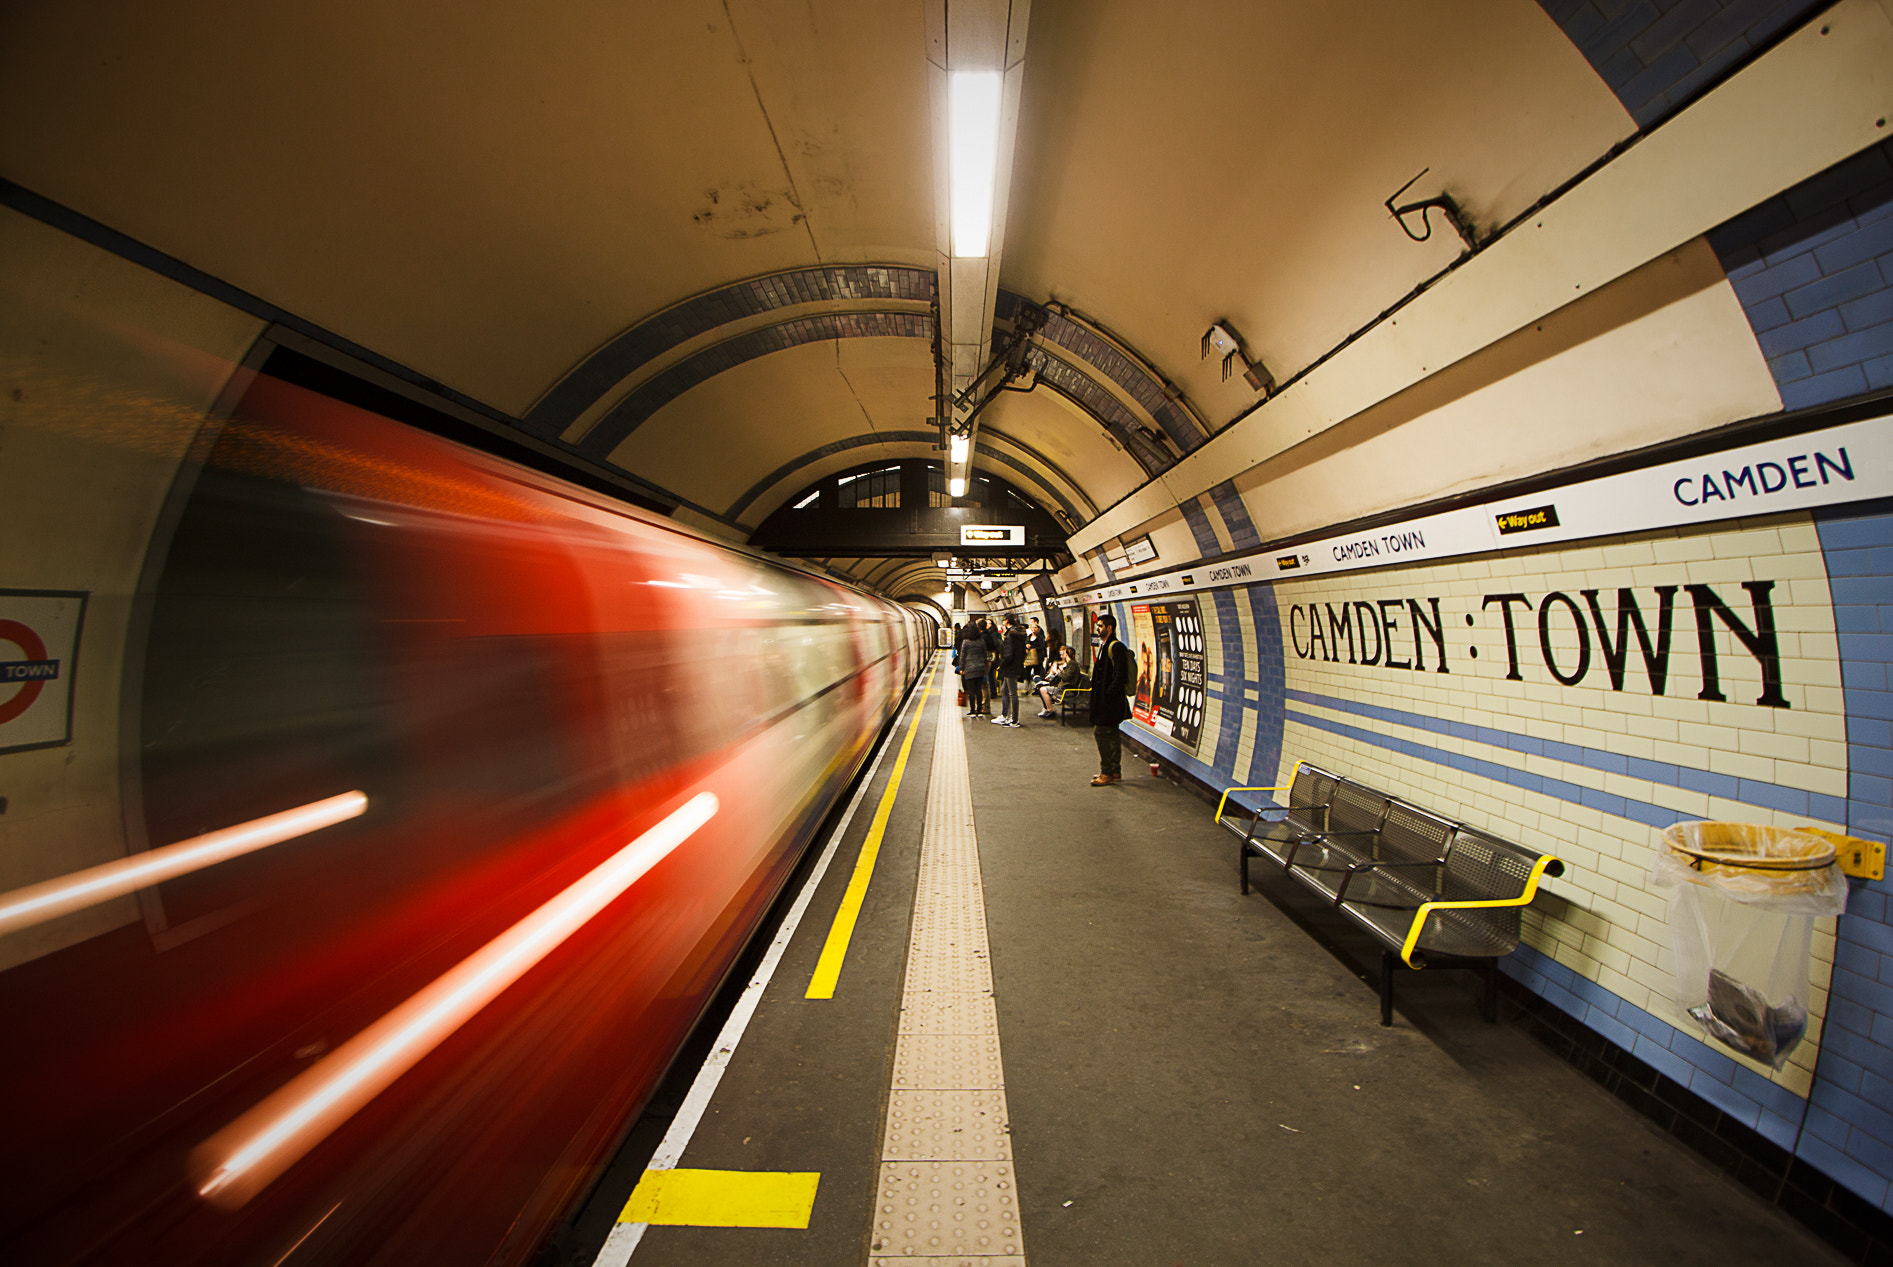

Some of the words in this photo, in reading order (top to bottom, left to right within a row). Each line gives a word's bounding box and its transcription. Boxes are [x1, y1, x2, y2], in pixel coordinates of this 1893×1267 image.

[1674, 447, 1855, 506] CAMDEN
[1506, 514, 1528, 528] Way
[1528, 510, 1547, 524] out
[1332, 539, 1380, 562] CAMDEN
[1381, 530, 1426, 554] TOWN
[1209, 568, 1232, 581] CAMDEN
[1231, 564, 1252, 578] TOWN
[1290, 597, 1450, 674] CAMDEN
[6, 664, 55, 678] TOWN
